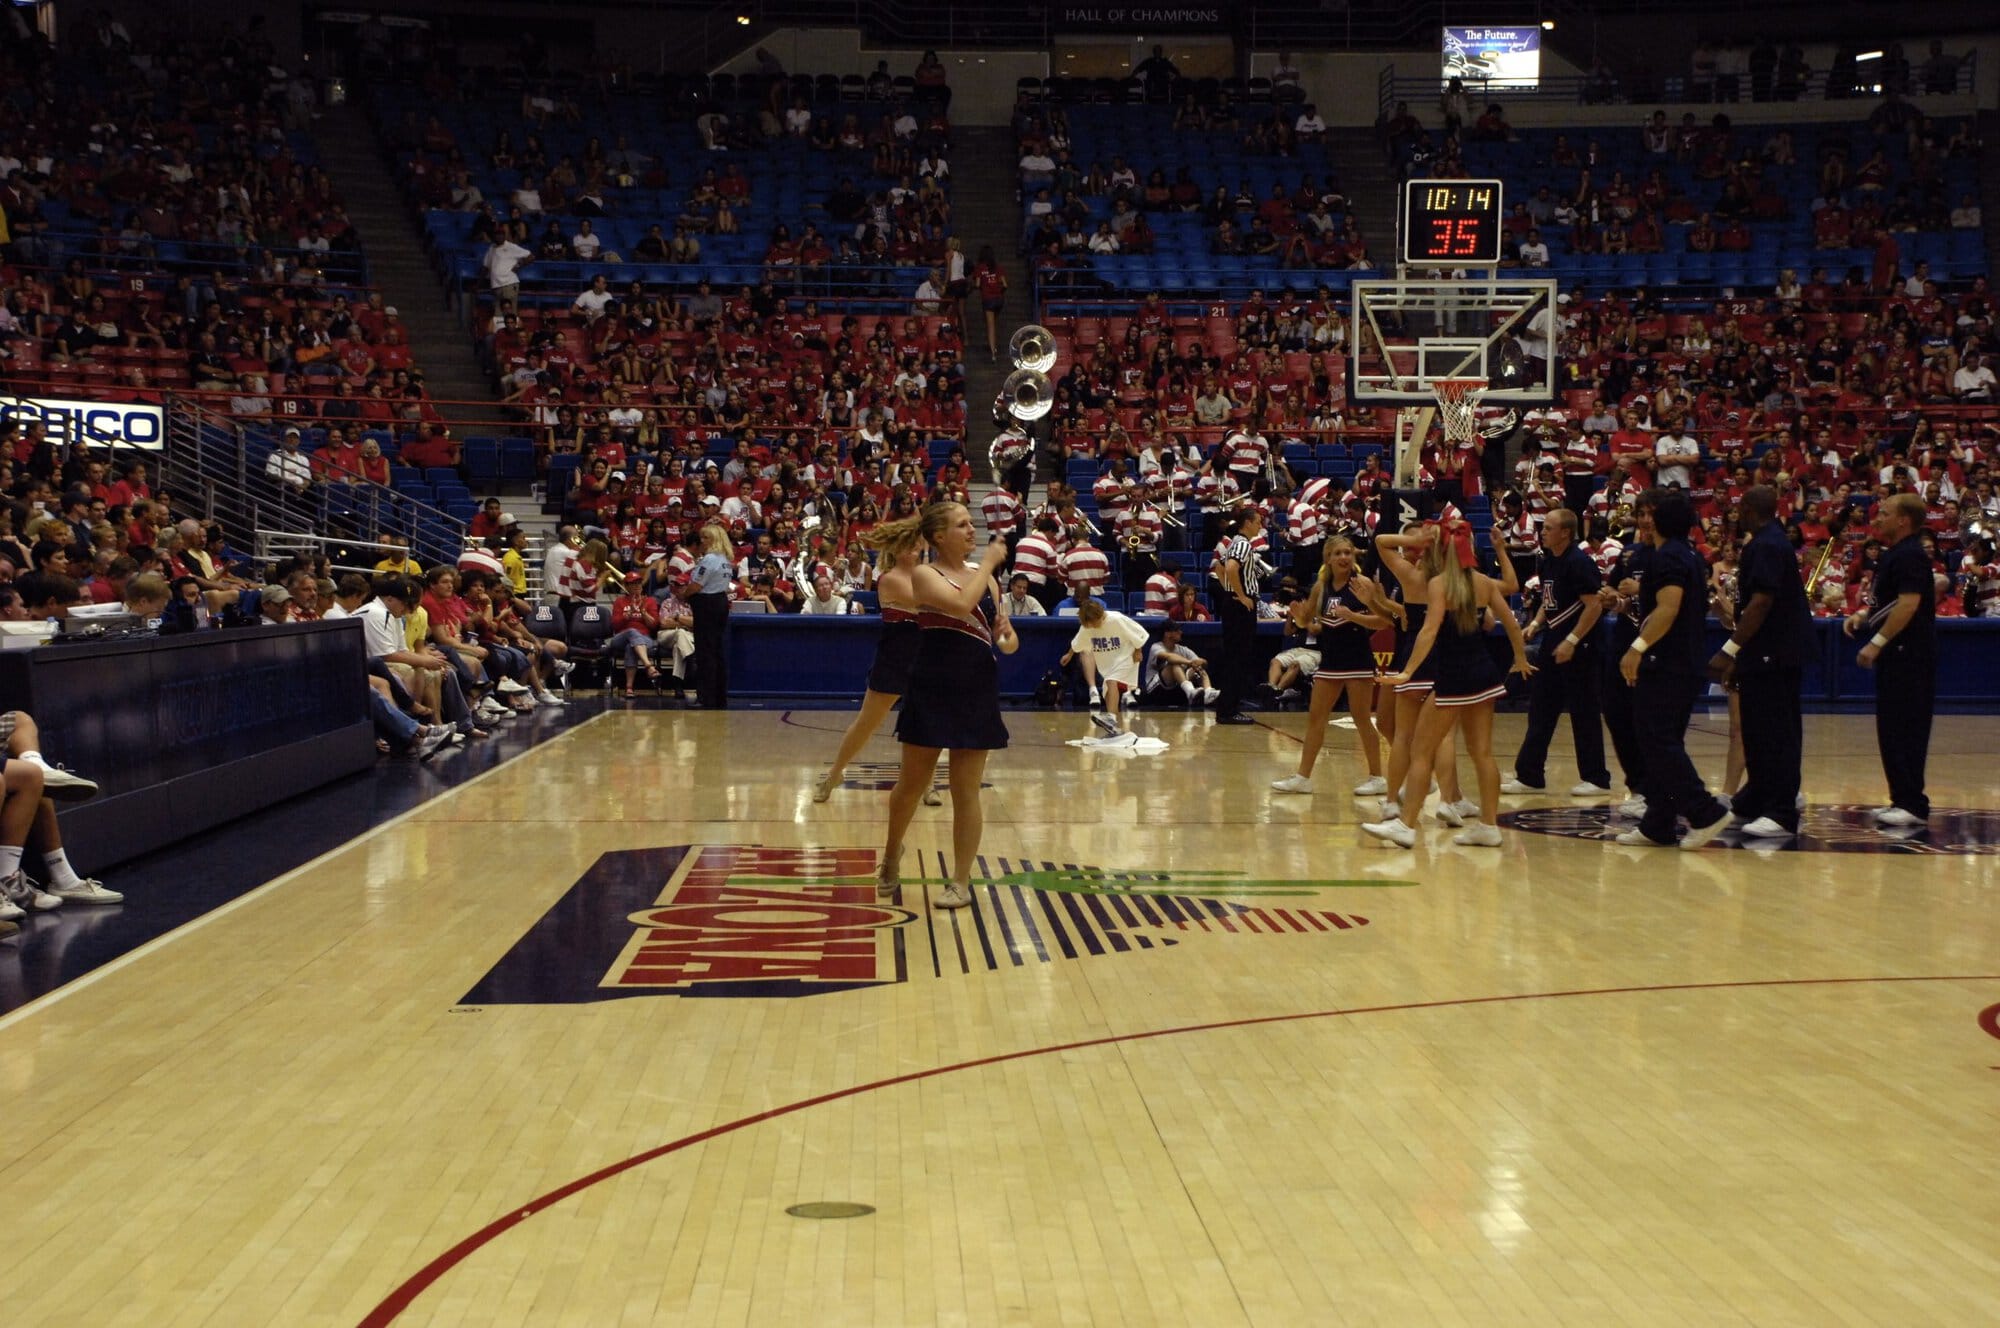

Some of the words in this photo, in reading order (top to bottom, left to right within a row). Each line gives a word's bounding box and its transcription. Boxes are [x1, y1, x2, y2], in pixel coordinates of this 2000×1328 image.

[1065, 8, 1102, 22] HALL
[1107, 8, 1127, 22] OF
[1132, 8, 1219, 22] CHAMPIONS
[1465, 29, 1482, 40] The
[1484, 29, 1518, 41] Future.
[1426, 187, 1492, 211] 10:14
[1427, 218, 1480, 256] 35
[130, 279, 144, 292] 19
[1211, 306, 1225, 318] 21
[1731, 303, 1747, 316] 22
[283, 400, 297, 414] 19
[0, 404, 160, 443] GEICO
[535, 606, 553, 621] A
[583, 606, 600, 621] A
